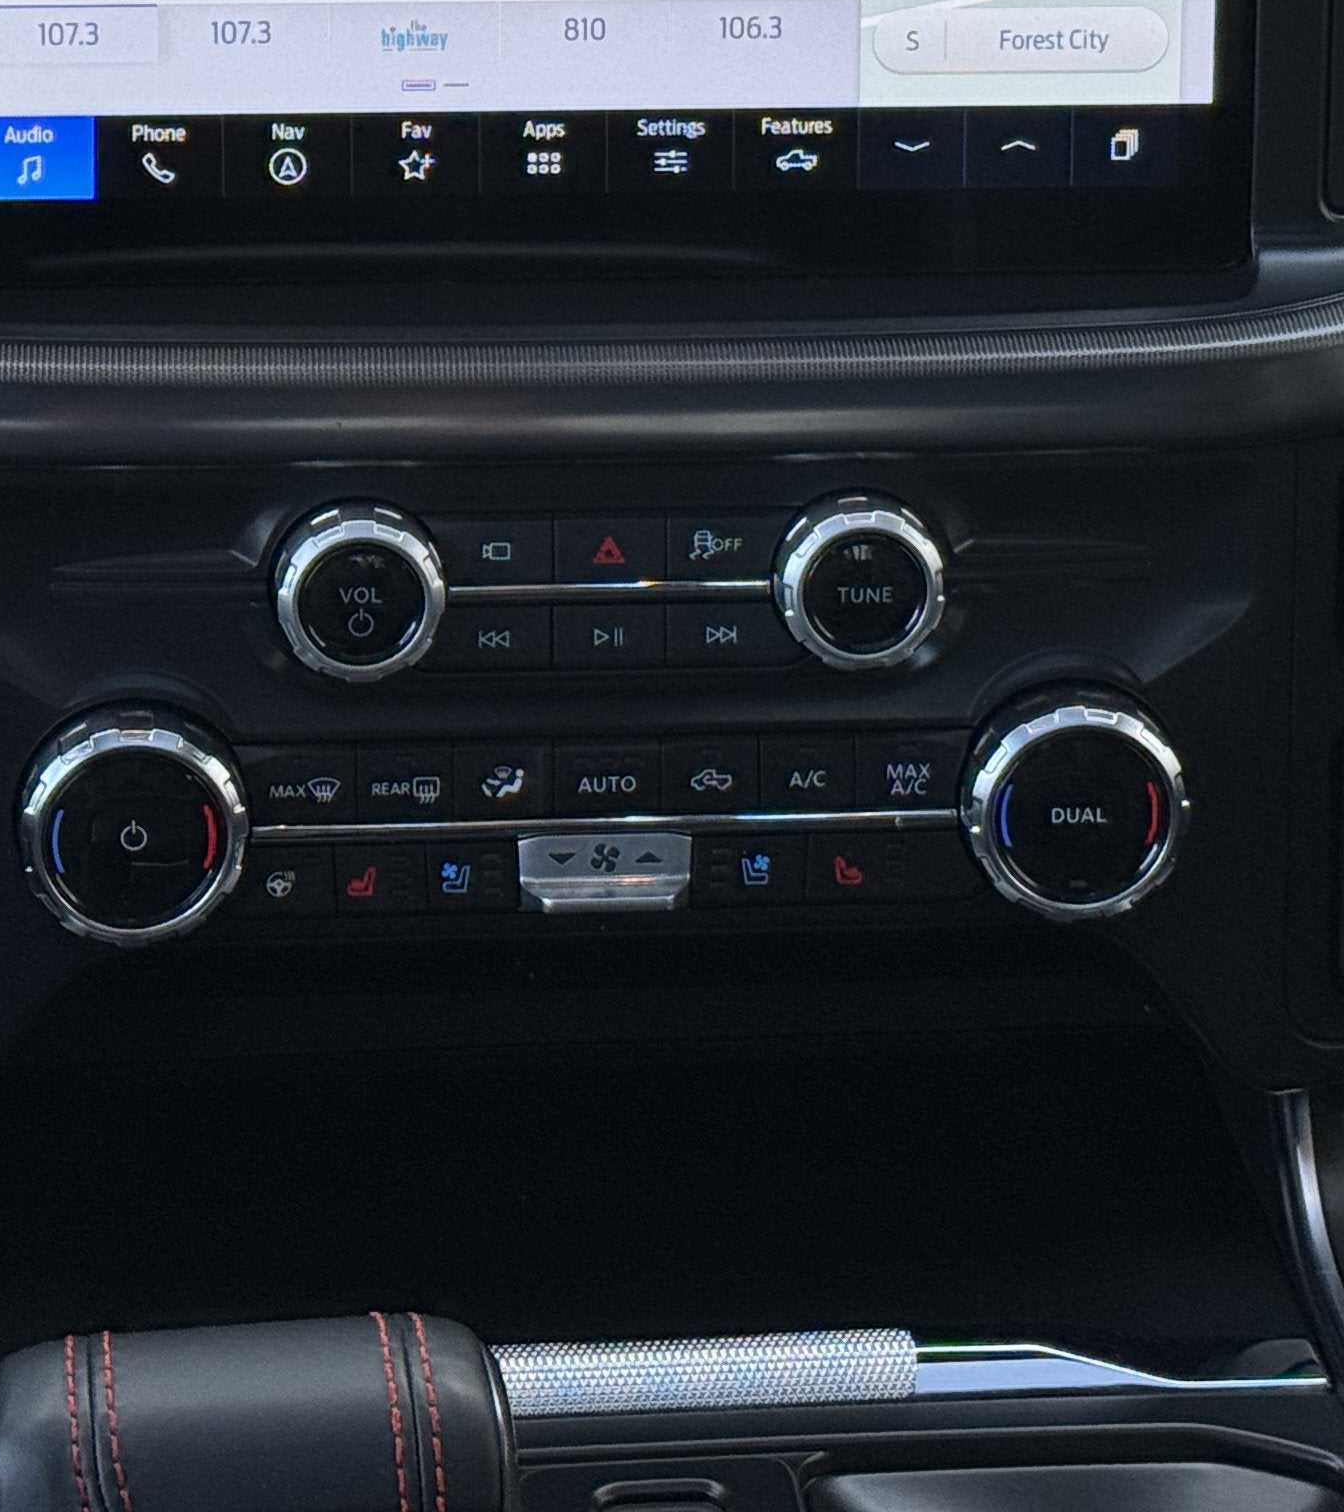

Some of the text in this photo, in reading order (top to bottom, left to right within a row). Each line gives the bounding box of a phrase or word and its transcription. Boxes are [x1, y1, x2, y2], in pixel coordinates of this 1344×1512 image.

[37, 21, 100, 47] 107.3
[210, 20, 272, 46] 107.3
[380, 25, 449, 52] highway
[564, 17, 607, 42] 810
[719, 16, 783, 41] 106.3
[905, 28, 1110, 55] S Forest City
[3, 123, 54, 144] Audio
[131, 122, 187, 143] Phone
[271, 122, 305, 142] Nav
[401, 121, 433, 141] Fav
[522, 120, 566, 143] Apps
[636, 117, 706, 140] Settings
[760, 117, 834, 137] Features
[713, 536, 744, 553] OFF
[338, 586, 383, 605] VOL
[836, 586, 894, 603] TUNE
[788, 770, 827, 788] A/C
[885, 762, 931, 780] MAX
[268, 784, 306, 800] MAX
[370, 782, 411, 798] REAR
[577, 775, 637, 794] AUTO
[889, 778, 929, 796] A/C
[1050, 807, 1108, 825] DUAL
